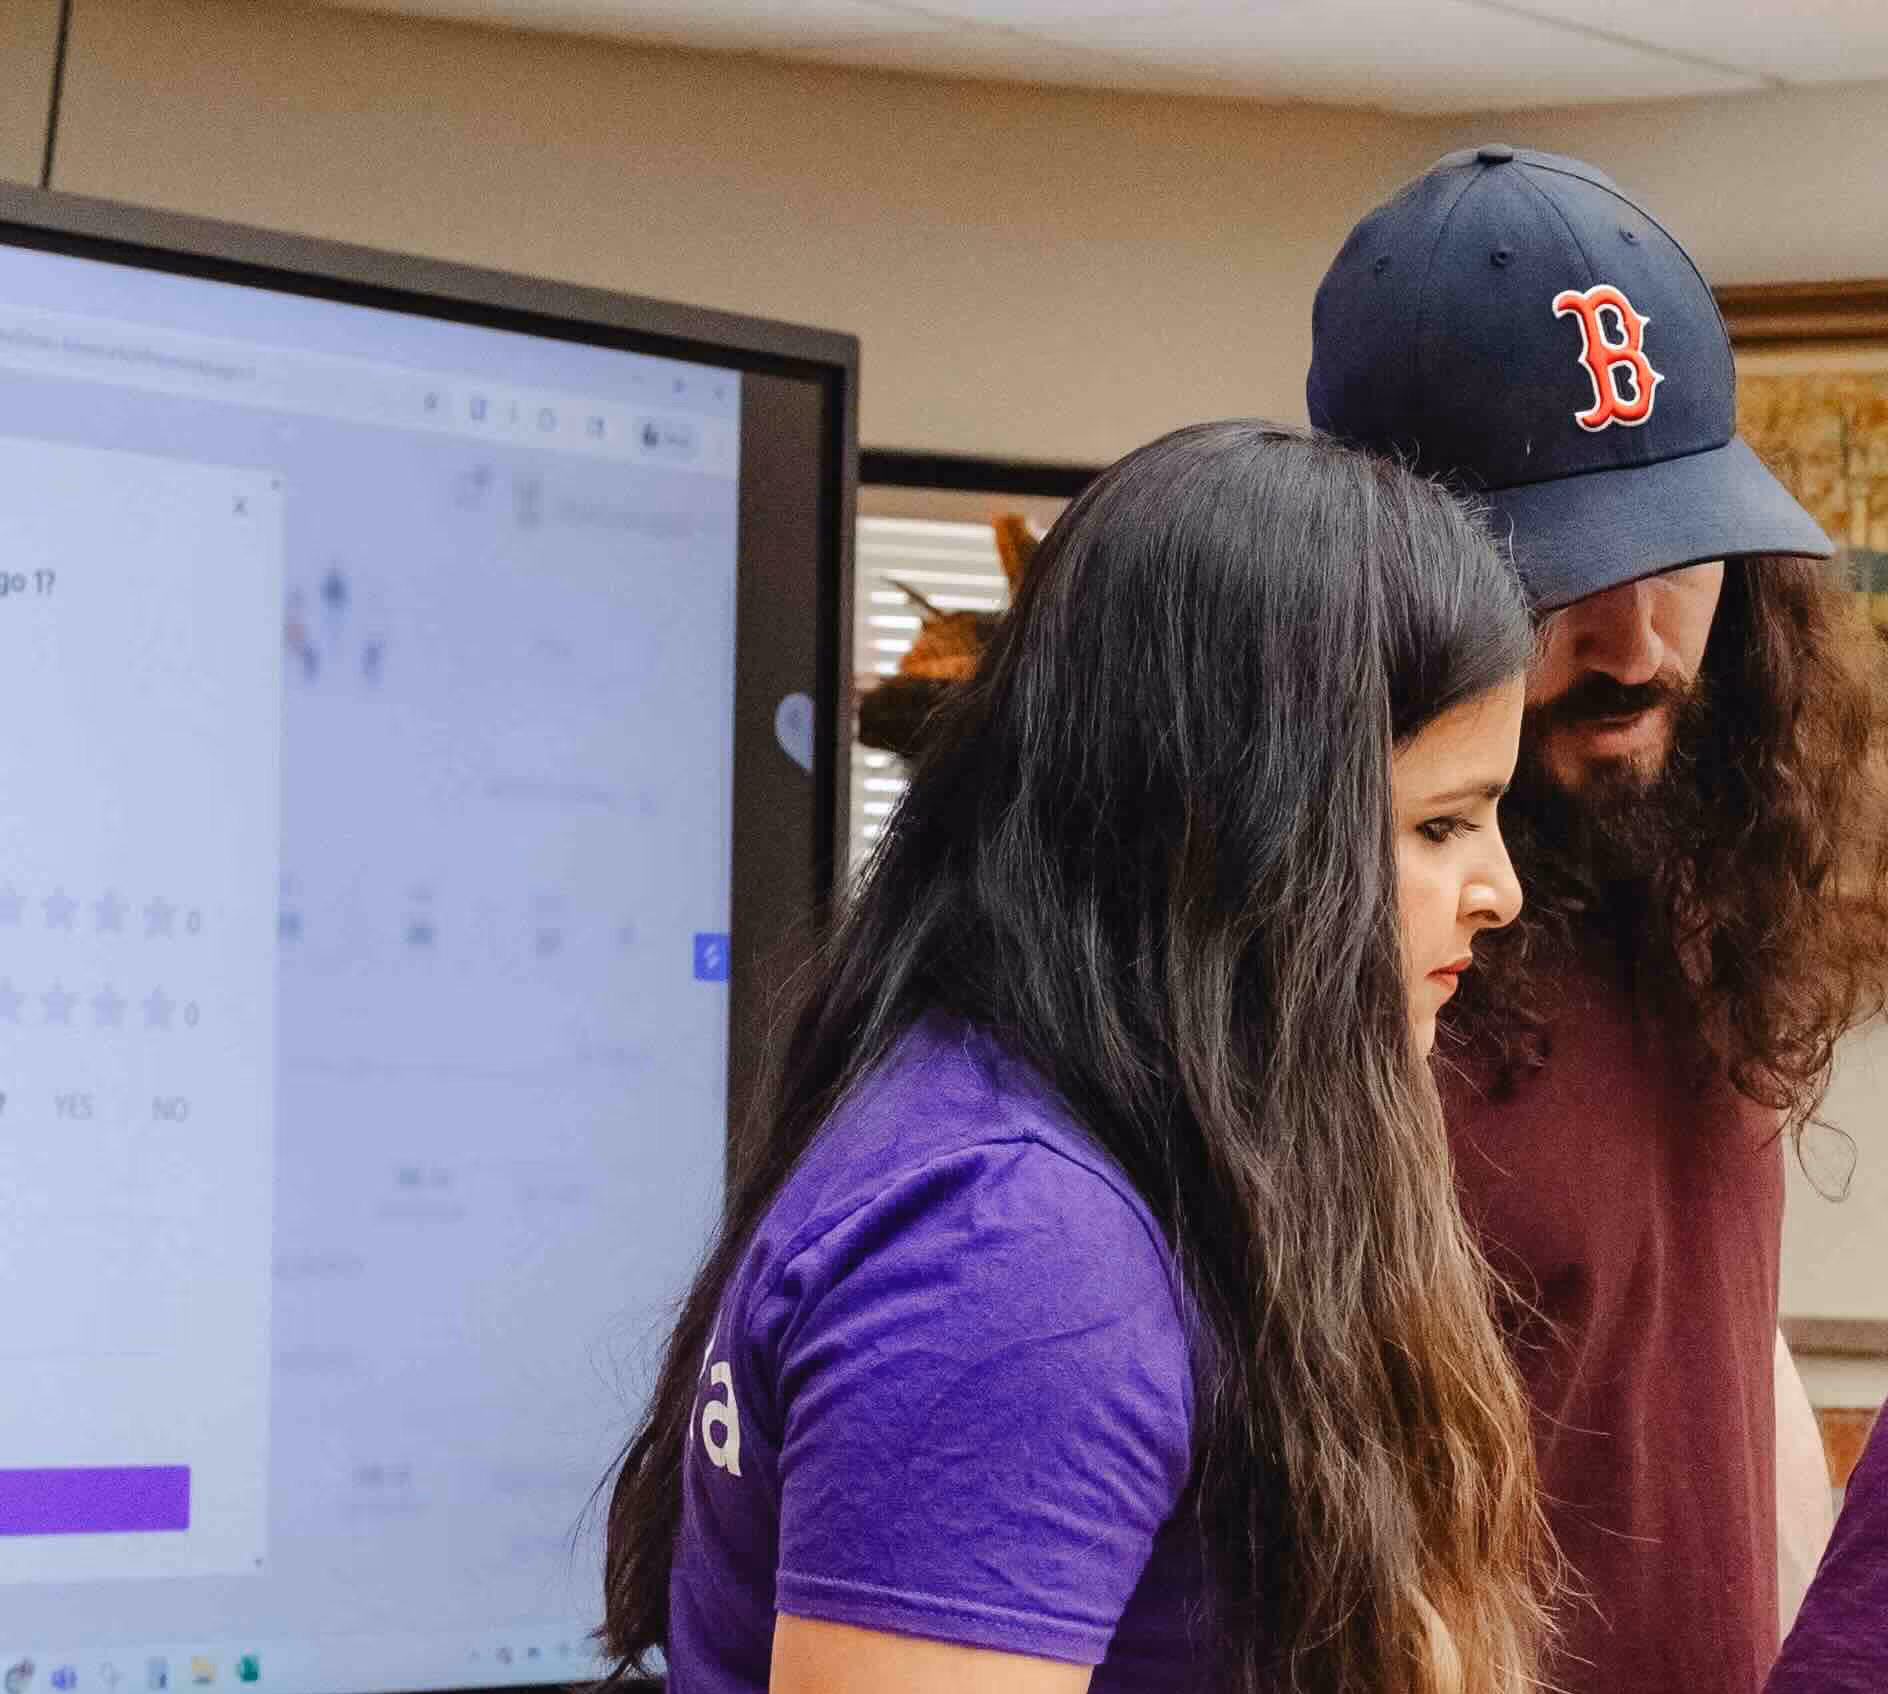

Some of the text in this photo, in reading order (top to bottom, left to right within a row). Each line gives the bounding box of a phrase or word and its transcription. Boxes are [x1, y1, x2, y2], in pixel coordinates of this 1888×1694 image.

[1552, 284, 1665, 432] B
[54, 1092, 190, 1122] YES NO
